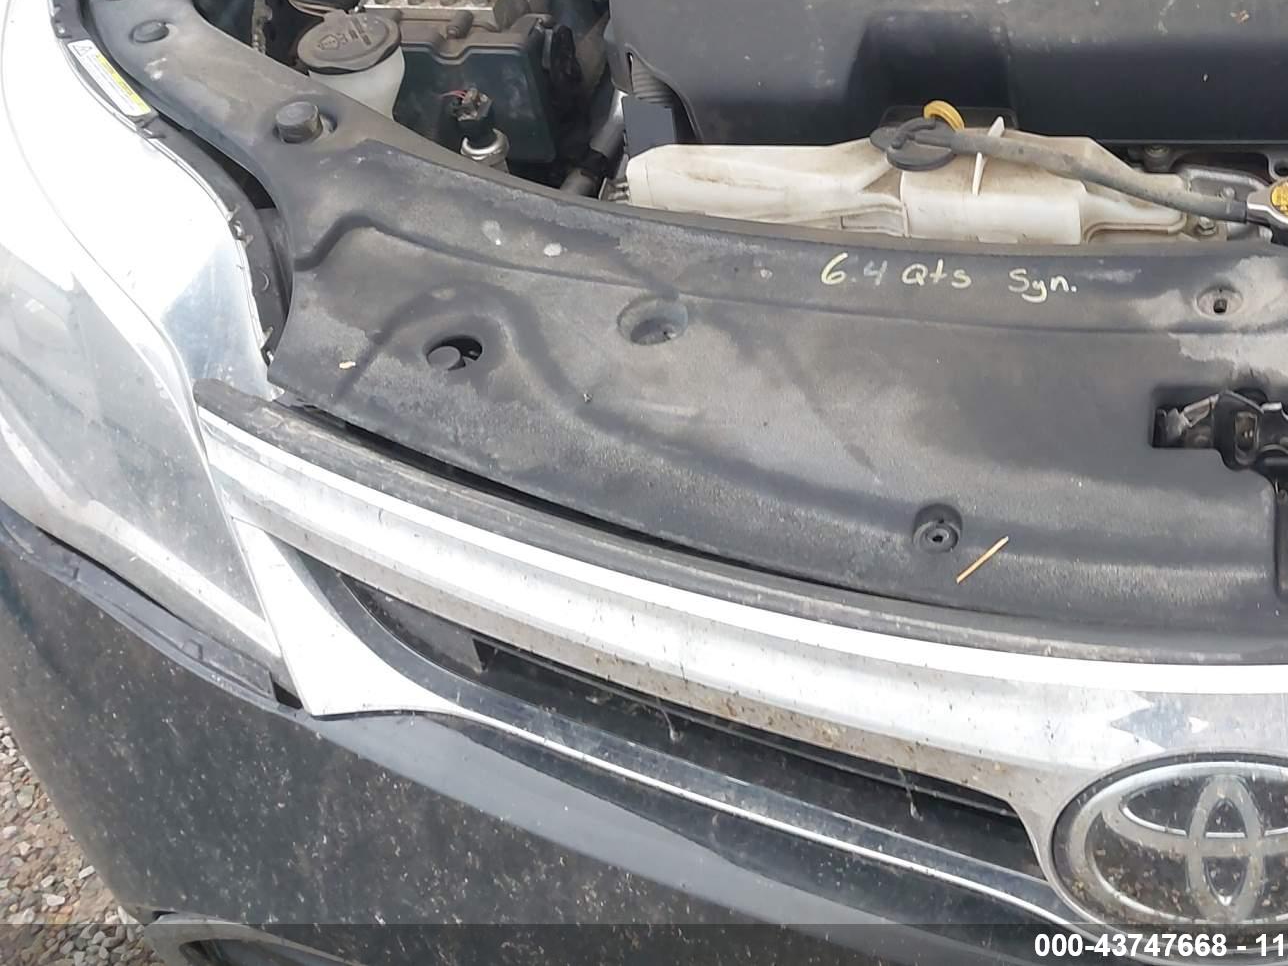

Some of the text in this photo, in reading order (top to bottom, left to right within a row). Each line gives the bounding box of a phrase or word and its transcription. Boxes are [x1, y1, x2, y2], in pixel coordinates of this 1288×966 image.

[820, 252, 1077, 303] 6.4 Qts Syn.
